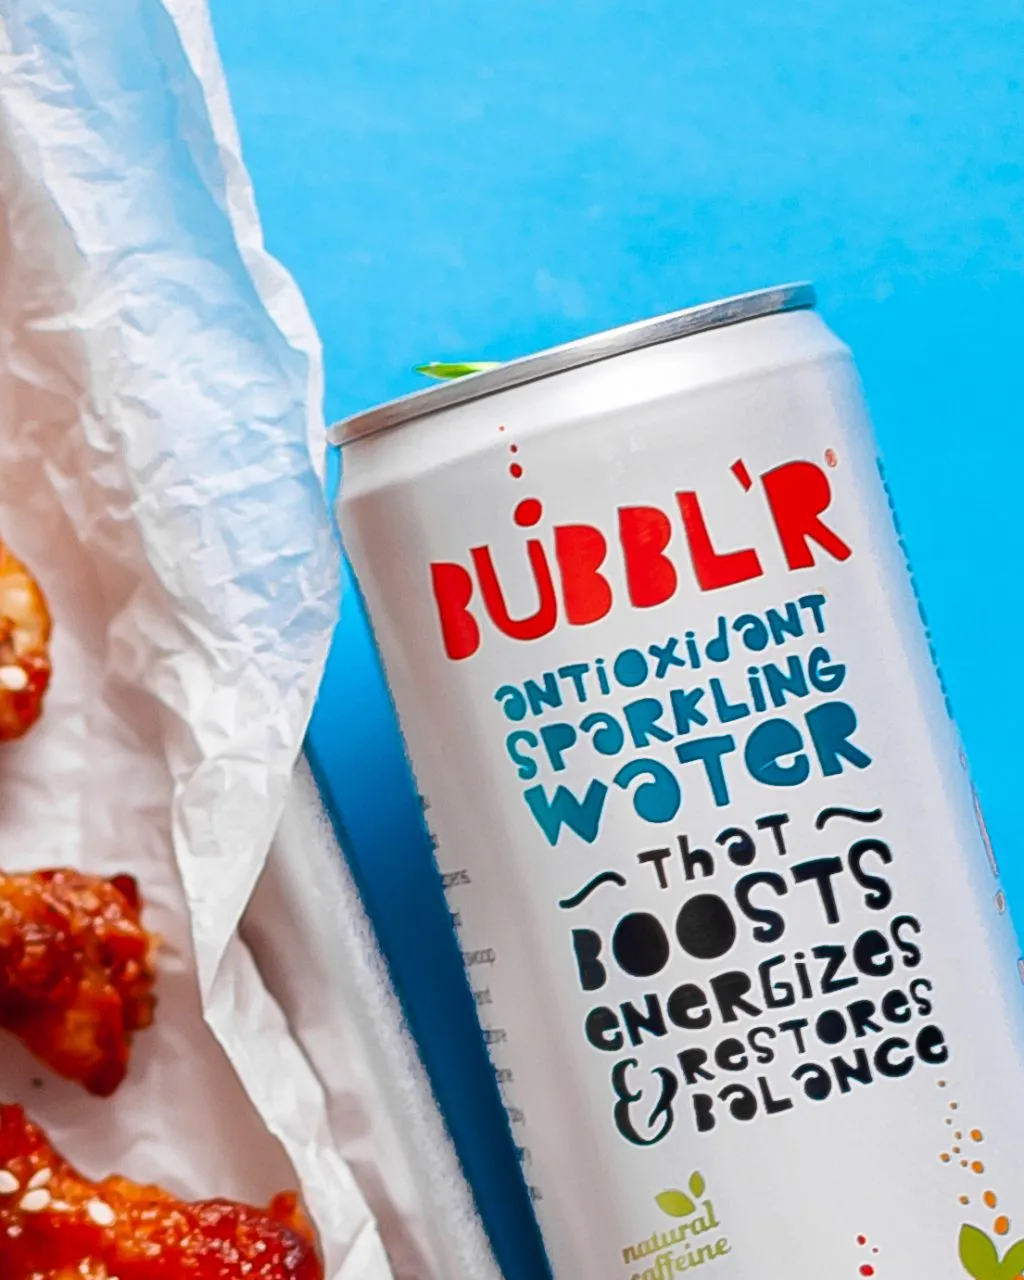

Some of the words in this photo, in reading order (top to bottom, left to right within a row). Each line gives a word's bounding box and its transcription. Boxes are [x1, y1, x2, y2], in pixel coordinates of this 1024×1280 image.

[572, 838, 893, 991] BOOSTS
[611, 1058, 678, 1147] &
[622, 1199, 720, 1264] natural
